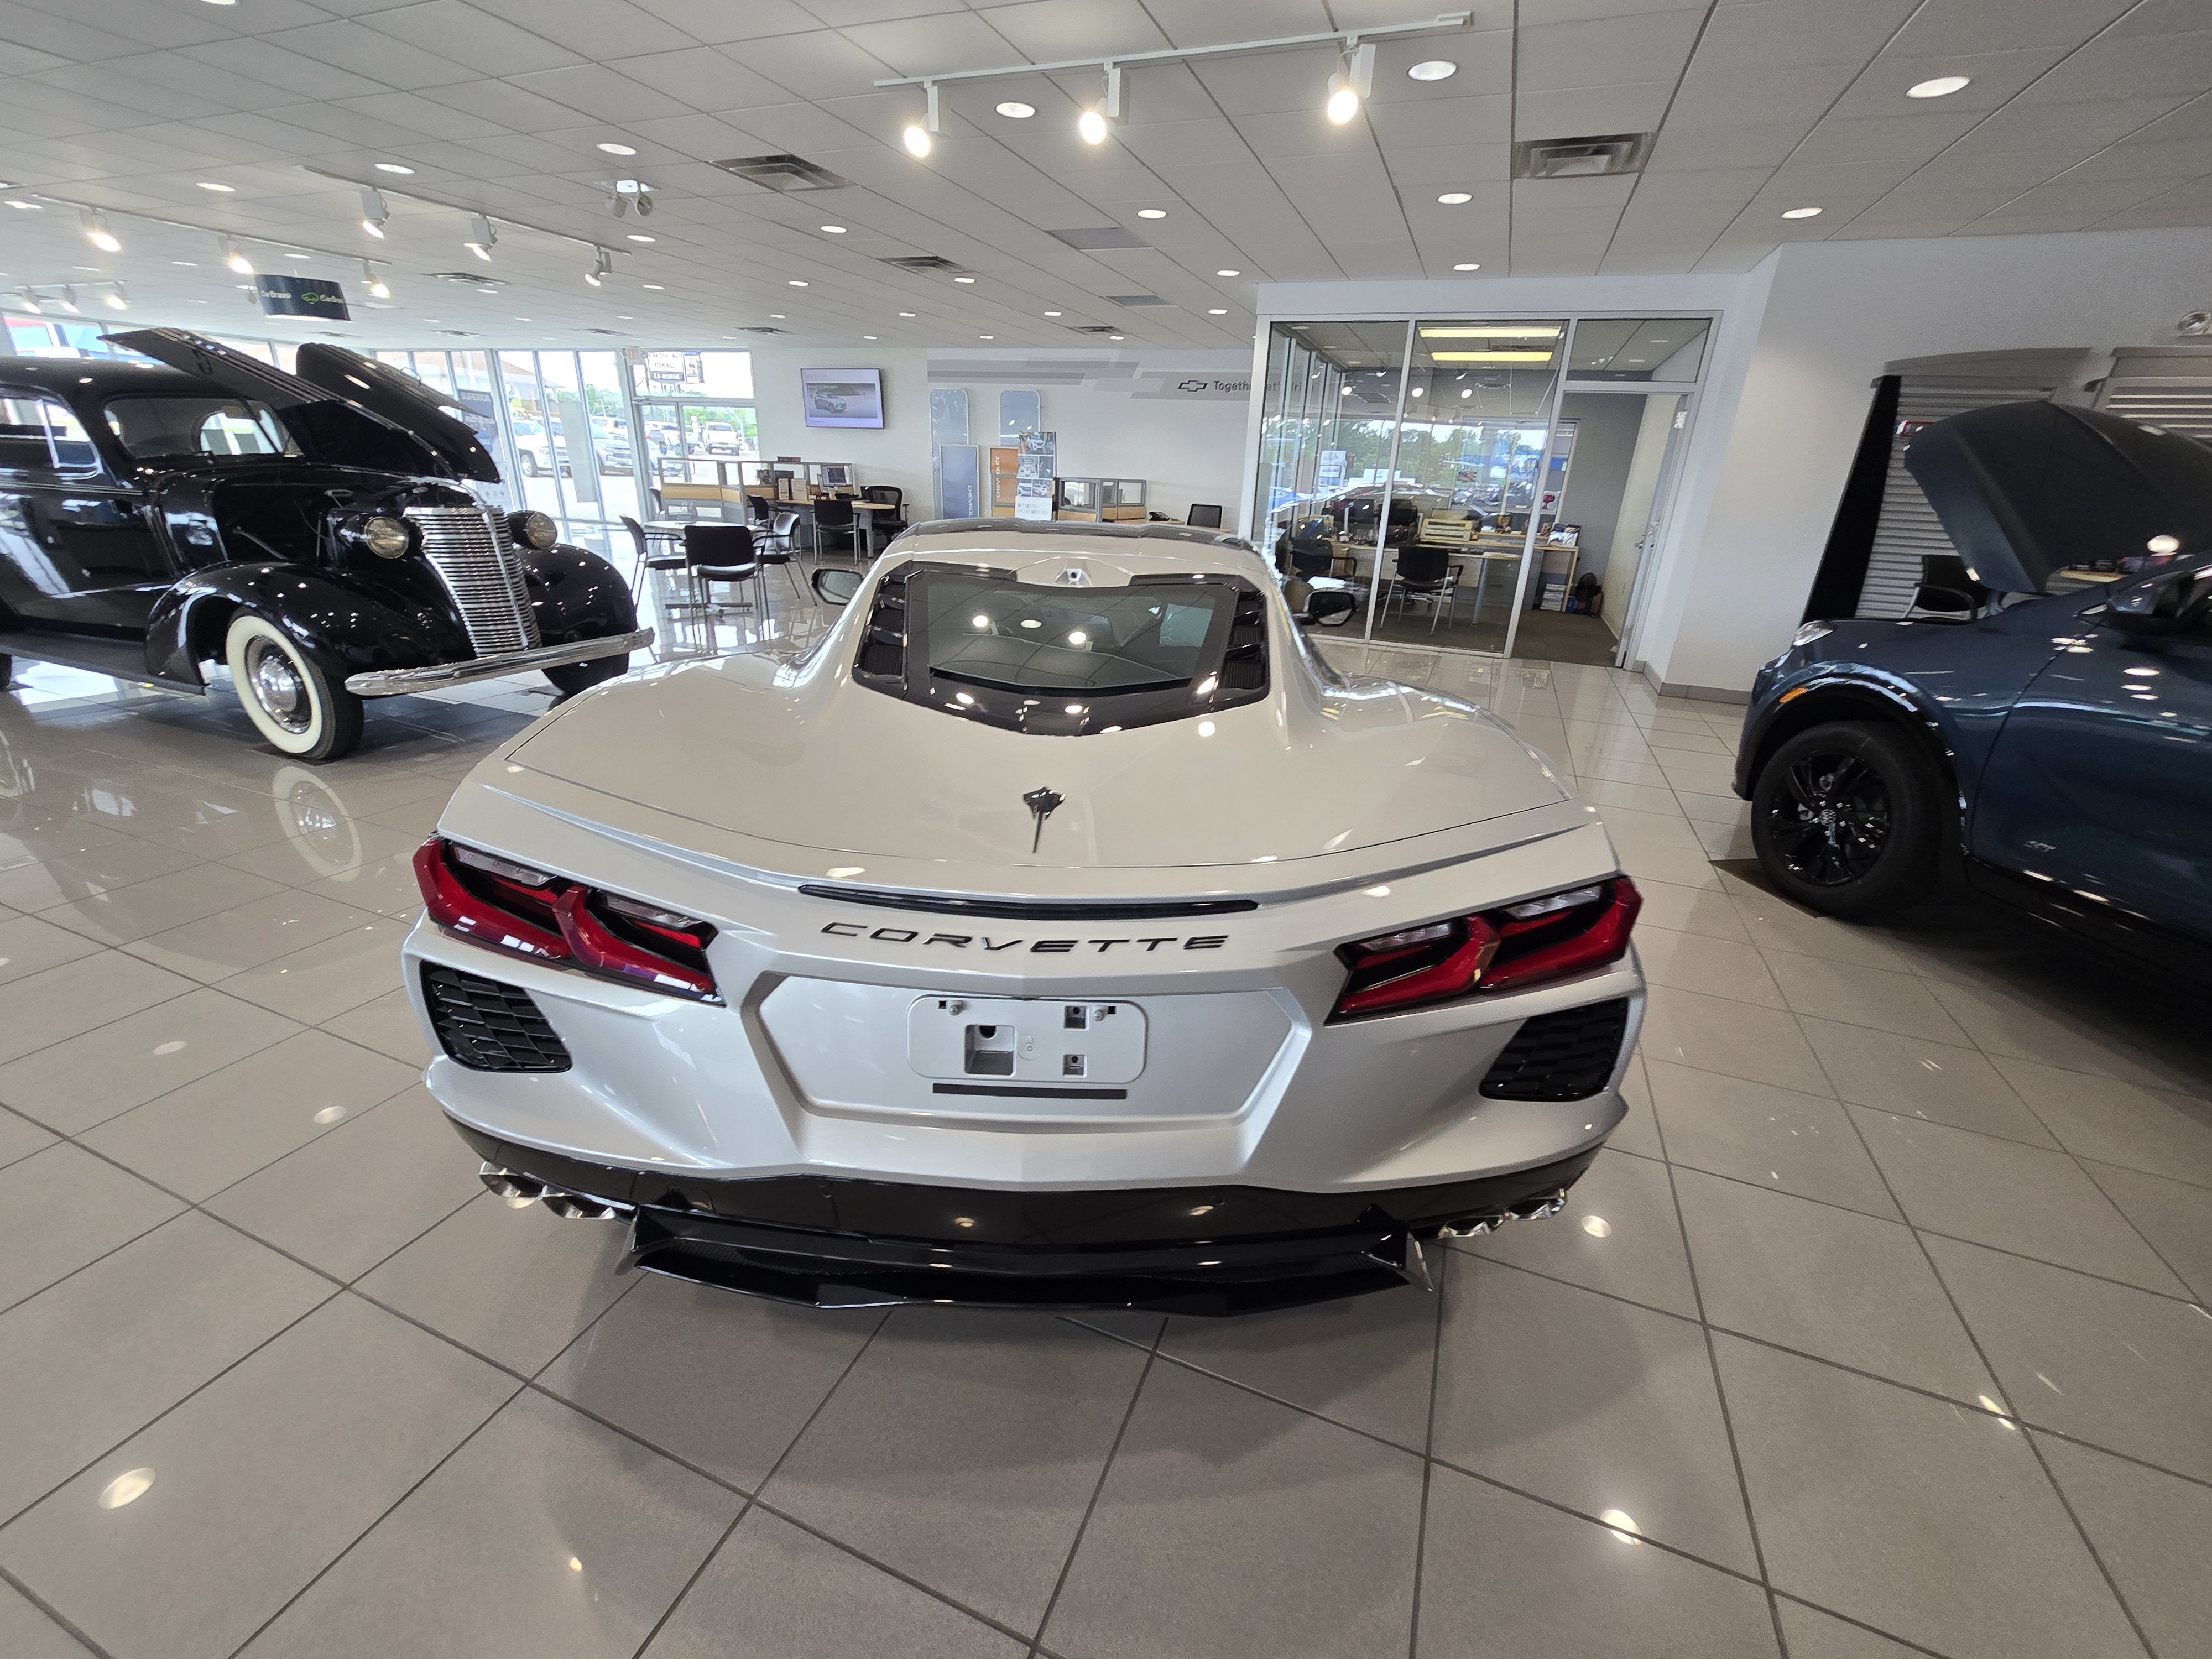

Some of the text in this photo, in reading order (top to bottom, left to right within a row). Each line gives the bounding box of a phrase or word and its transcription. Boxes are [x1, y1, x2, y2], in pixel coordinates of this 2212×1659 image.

[1213, 380, 1251, 393] Togeth
[460, 392, 491, 403] SUPERIOR
[820, 921, 1229, 953] CORVETTE
